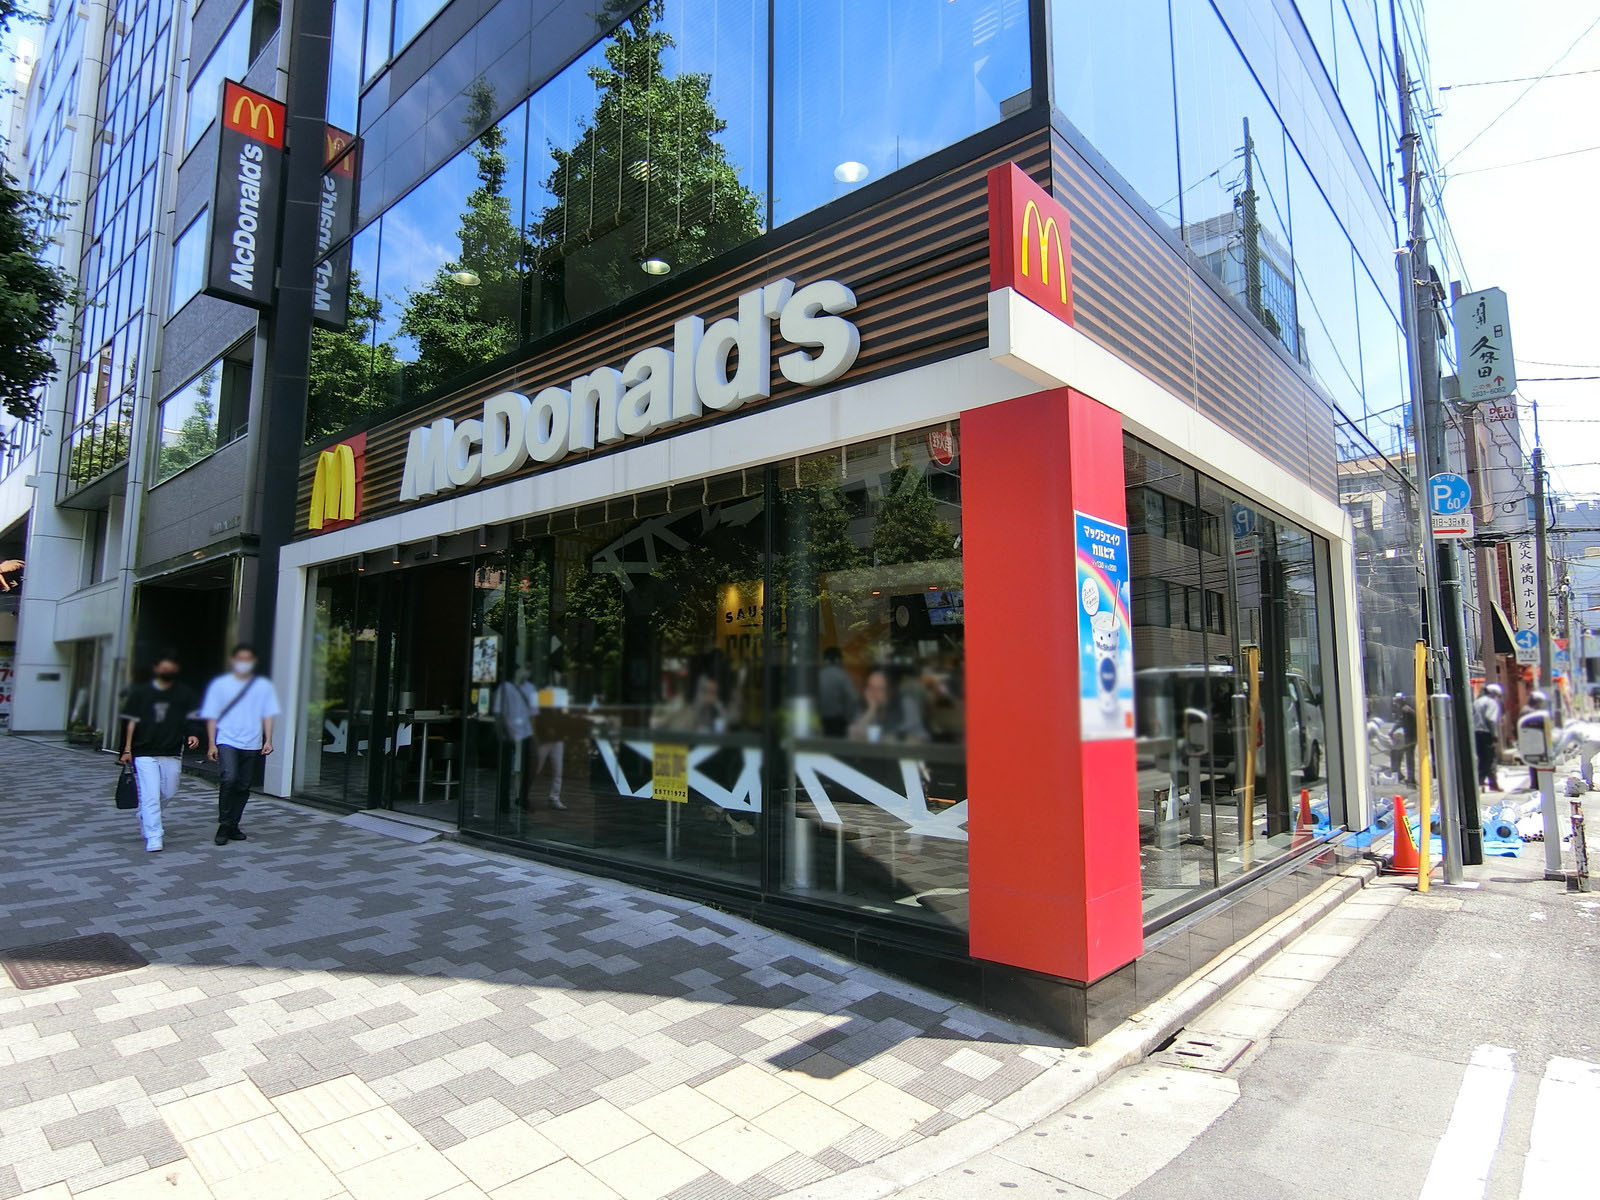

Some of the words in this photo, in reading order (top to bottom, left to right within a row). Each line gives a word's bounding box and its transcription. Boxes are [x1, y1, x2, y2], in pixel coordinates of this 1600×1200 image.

[229, 143, 263, 291] McDonald's
[400, 277, 861, 501] McDonald's
[1470, 335, 1500, 378] 久保田
[1434, 485, 1452, 510] P
[1447, 498, 1461, 510] 60
